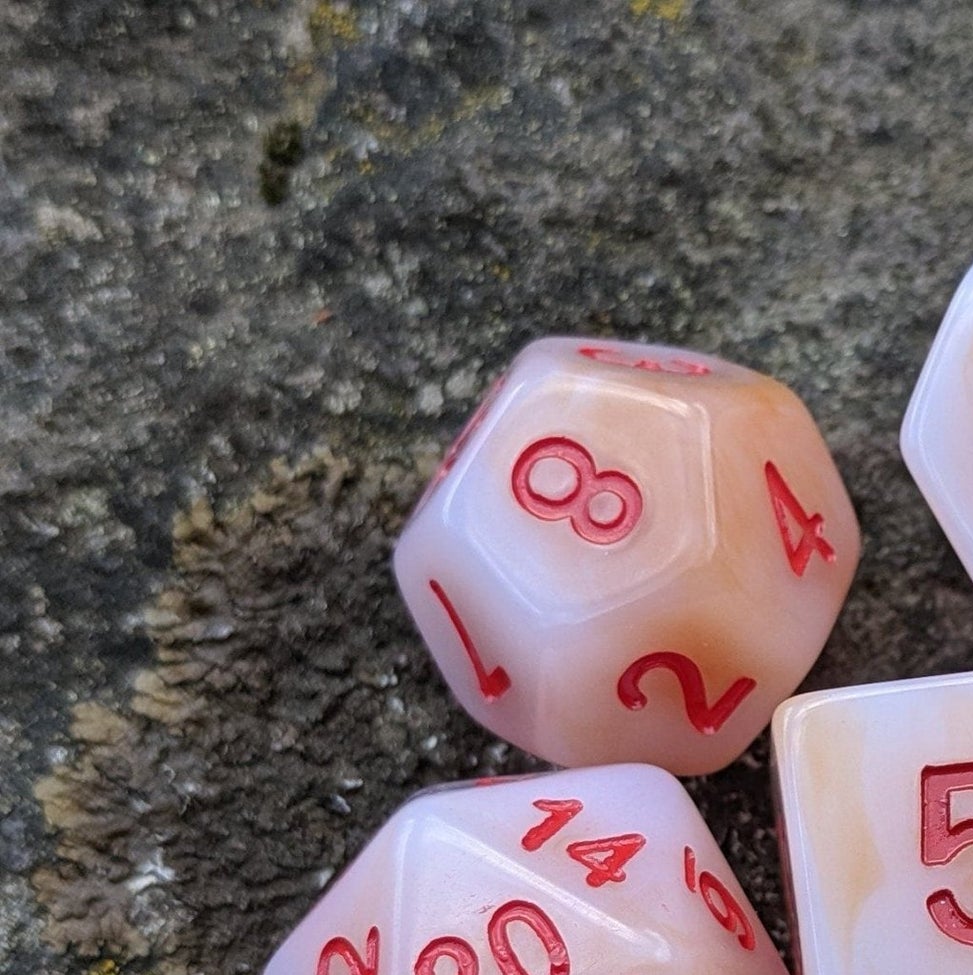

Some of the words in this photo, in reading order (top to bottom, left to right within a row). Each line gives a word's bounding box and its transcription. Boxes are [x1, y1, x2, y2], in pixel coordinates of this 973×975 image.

[511, 436, 643, 544] 8
[764, 460, 836, 578] 4
[430, 581, 512, 703] 1
[616, 650, 757, 736] 2
[520, 800, 645, 887] 14
